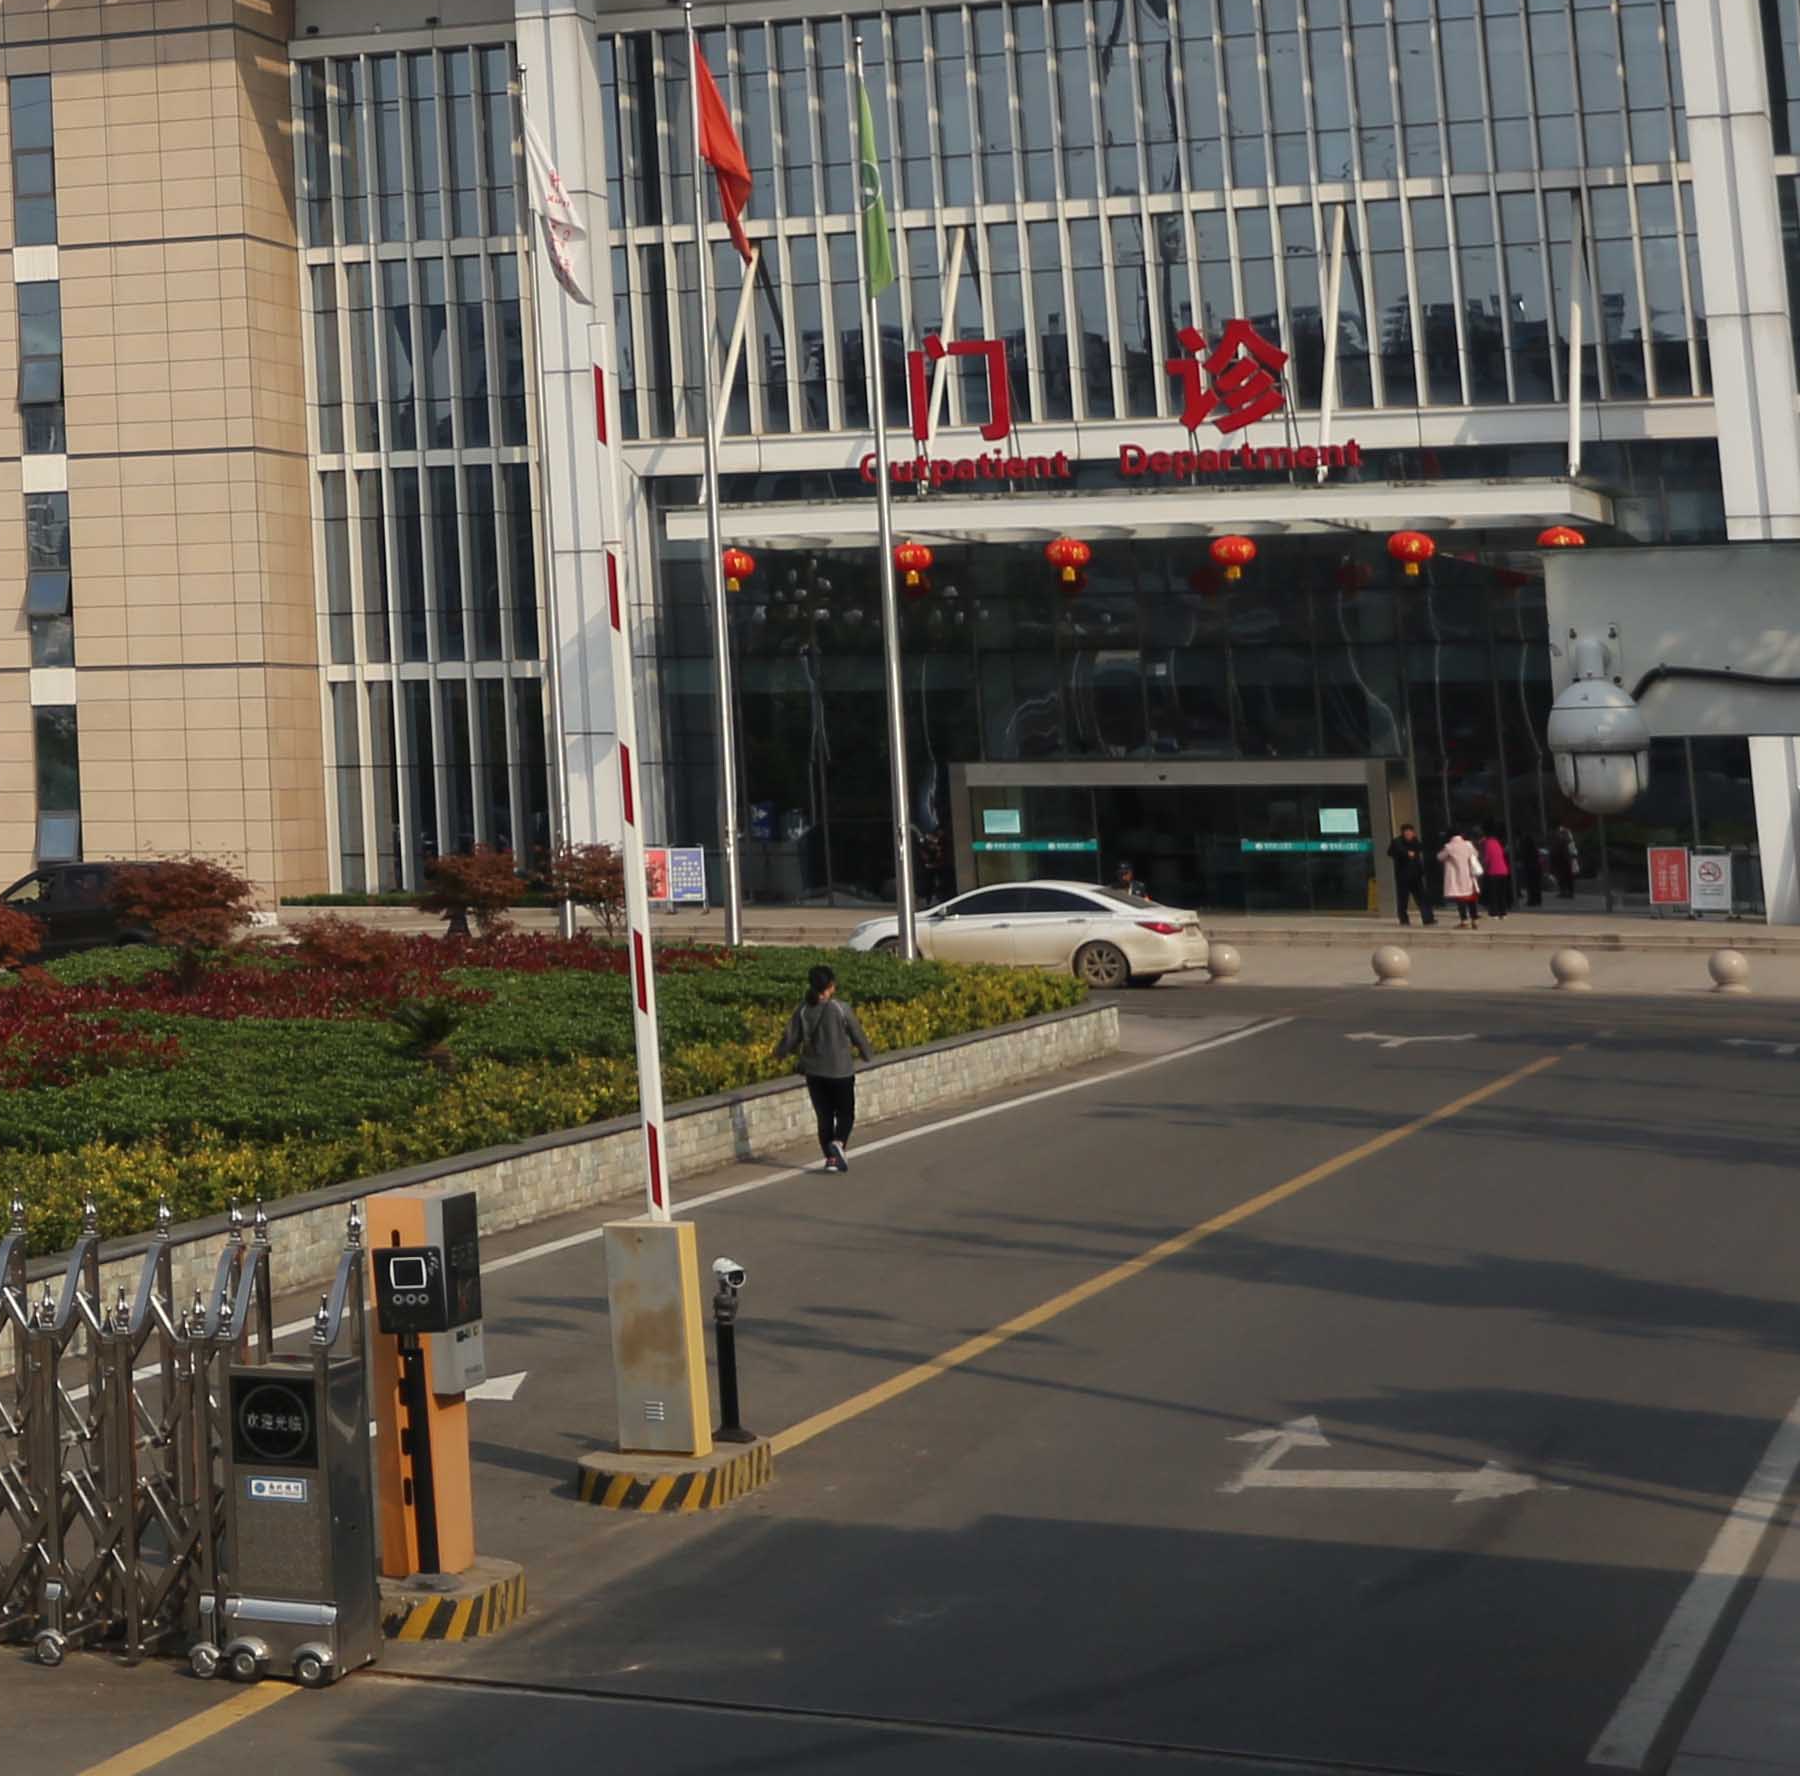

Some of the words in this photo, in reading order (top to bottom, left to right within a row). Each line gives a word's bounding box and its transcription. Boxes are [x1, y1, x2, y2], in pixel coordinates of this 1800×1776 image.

[907, 318, 1290, 442] 门诊
[857, 450, 1072, 489] Outpatient
[1118, 438, 1363, 481] Department
